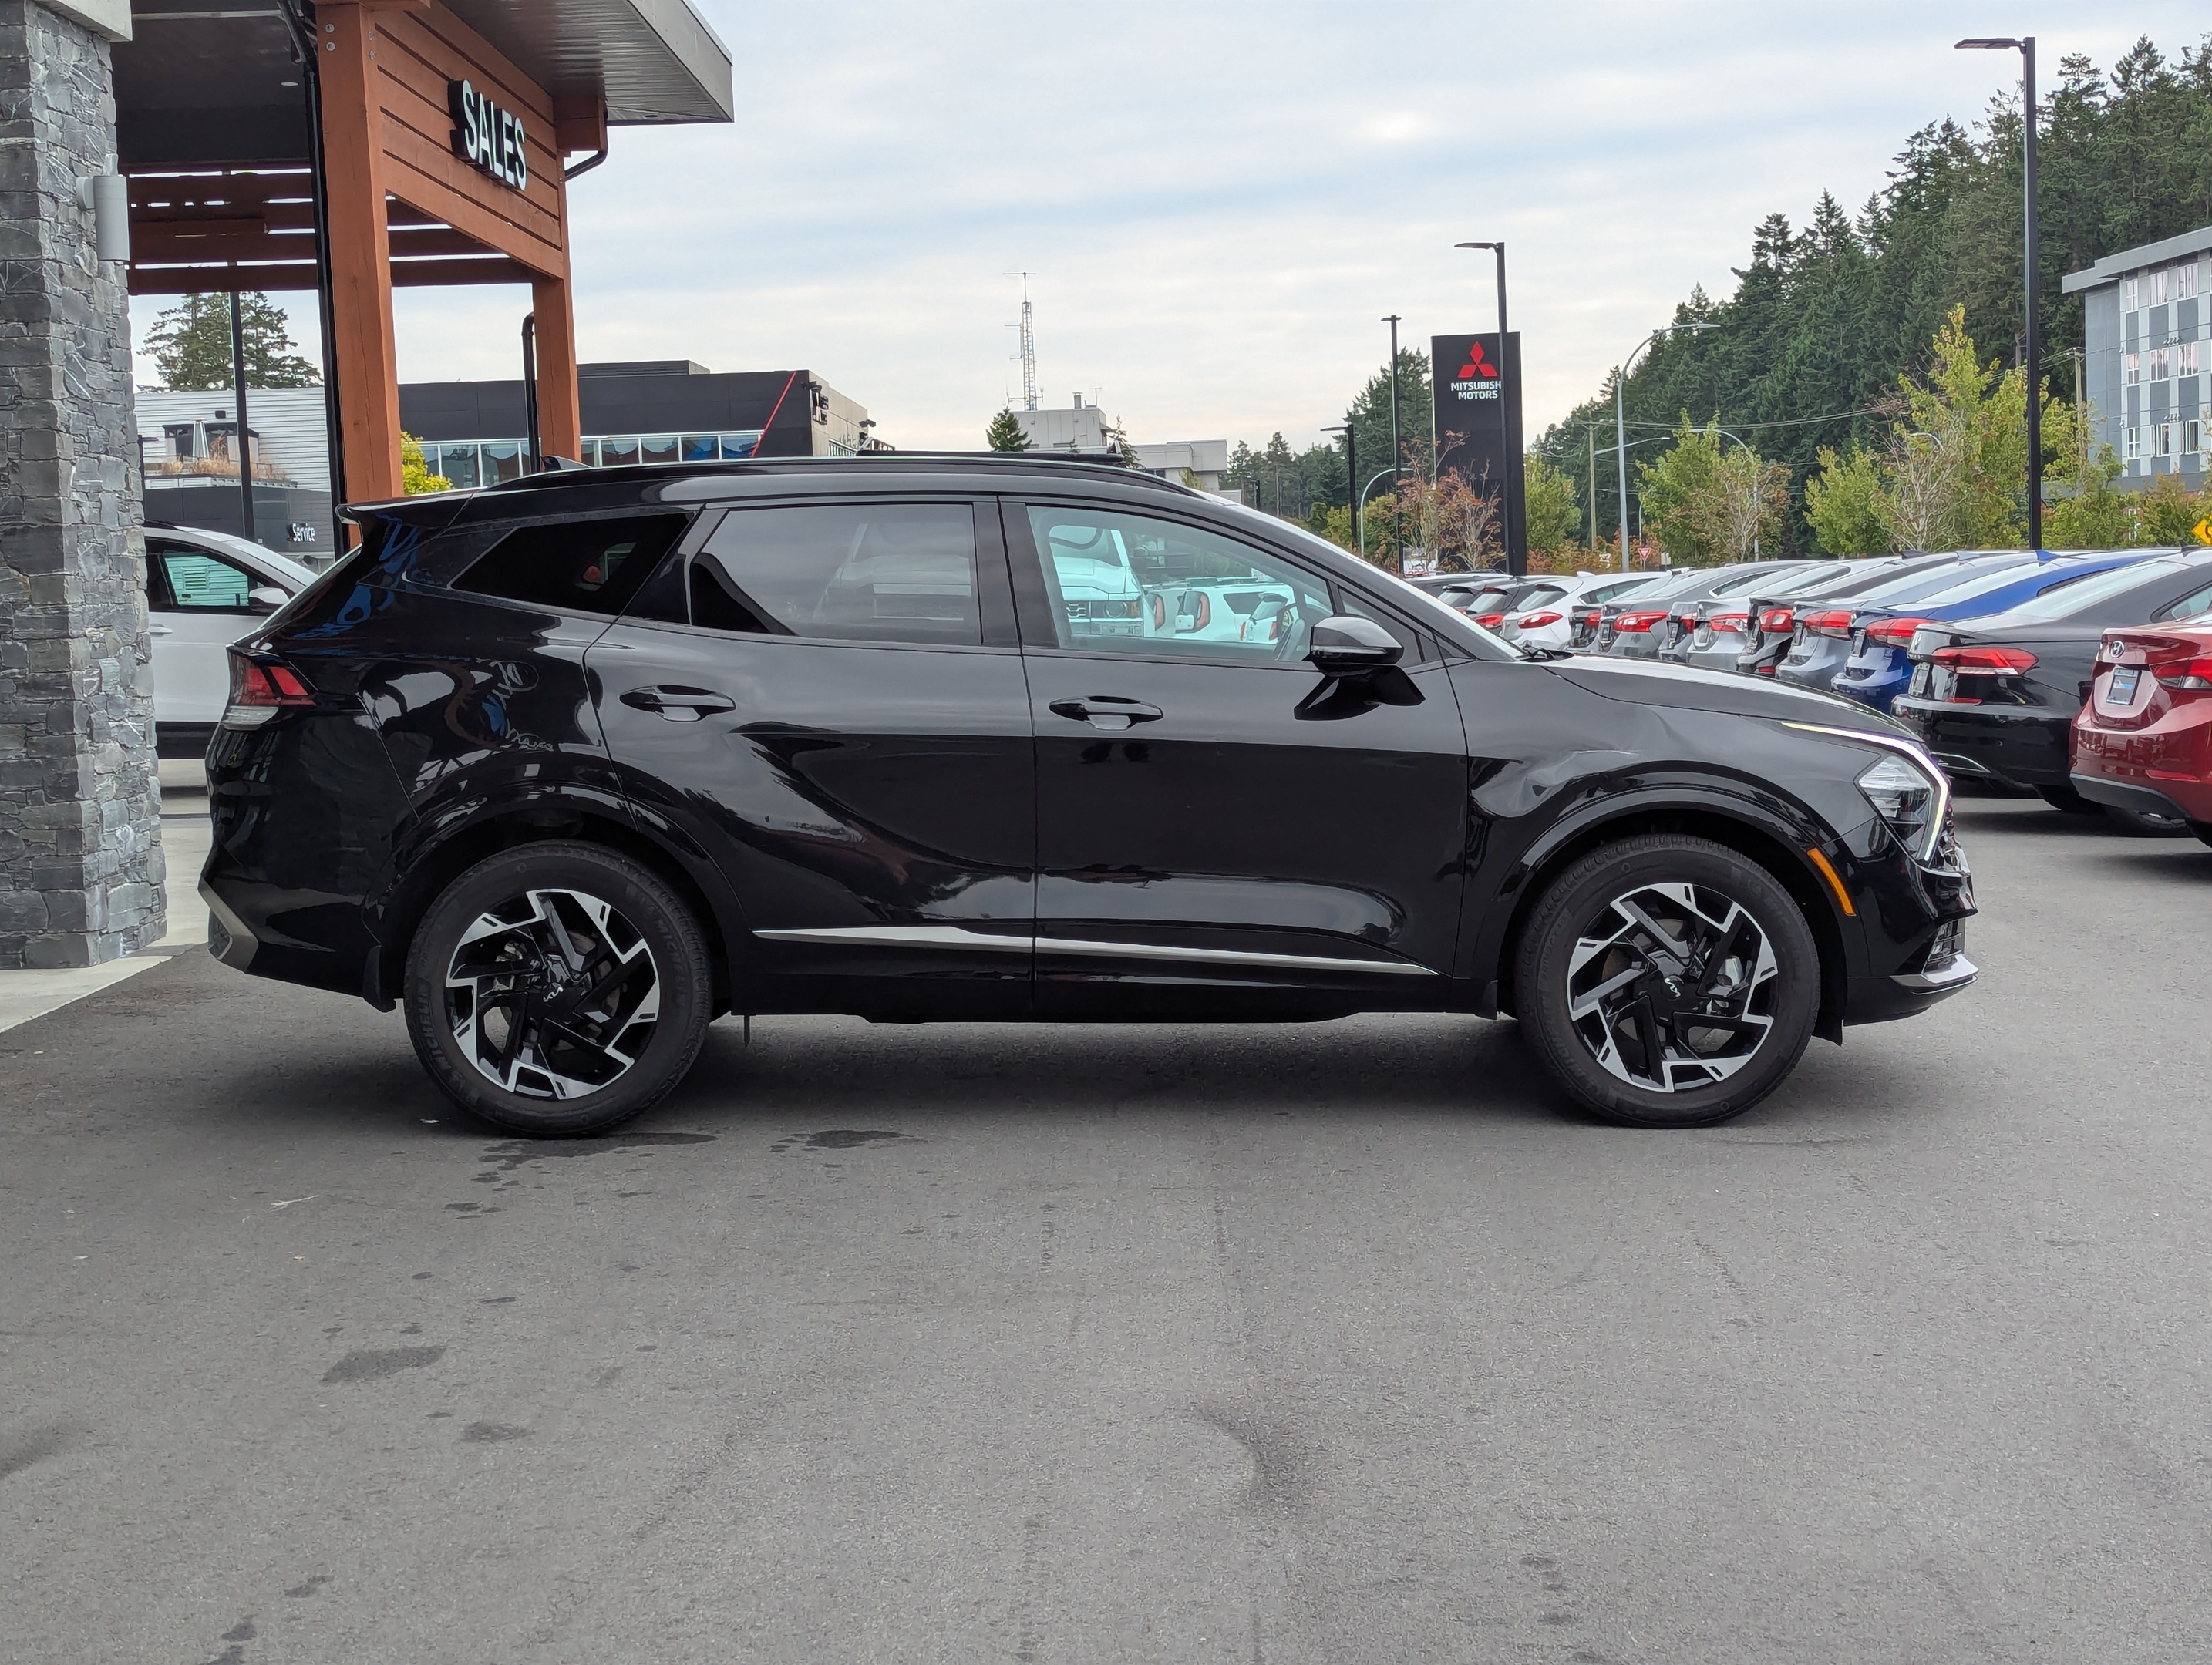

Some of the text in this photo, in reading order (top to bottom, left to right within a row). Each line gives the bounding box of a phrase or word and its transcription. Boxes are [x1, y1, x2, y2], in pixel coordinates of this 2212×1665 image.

[462, 79, 527, 191] SALES
[1450, 380, 1503, 392] MITSUBISH
[1458, 390, 1498, 400] MOTORS
[292, 522, 315, 542] Service
[418, 981, 452, 1070] MICHELIN
